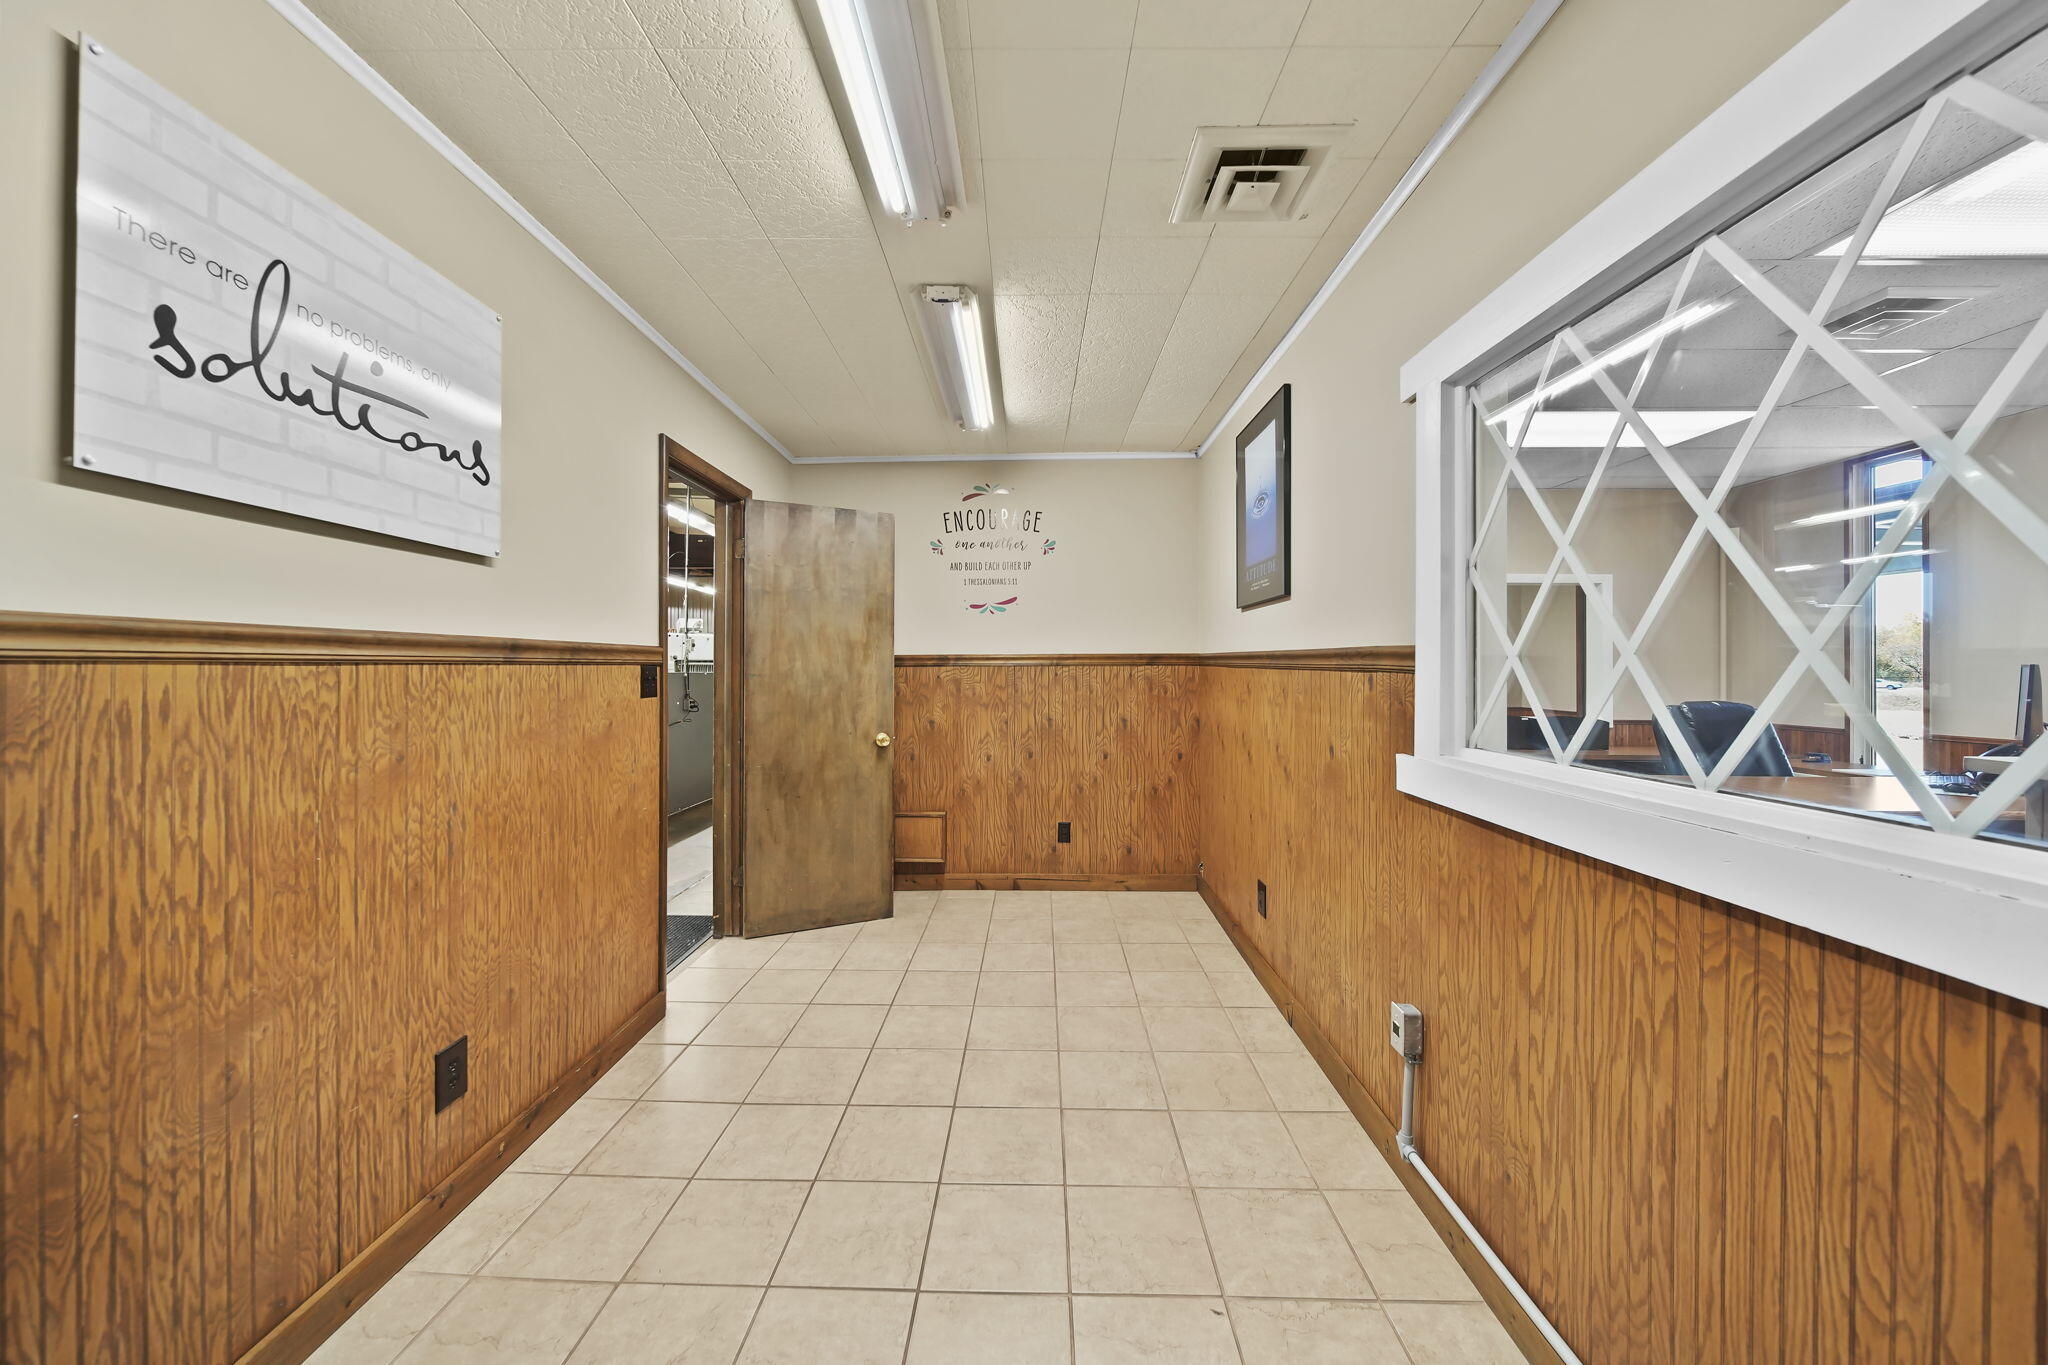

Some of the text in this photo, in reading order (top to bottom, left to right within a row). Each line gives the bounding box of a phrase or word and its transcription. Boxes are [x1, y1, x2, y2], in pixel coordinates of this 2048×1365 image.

[112, 206, 197, 265] There
[206, 257, 249, 291] are
[296, 302, 325, 329] no
[420, 363, 452, 393] only
[149, 259, 491, 486] solutions
[955, 536, 1028, 551] one another
[950, 562, 1032, 571] AND BUILD EACH OTHER UP
[968, 578, 1006, 586] THESSALONIANS
